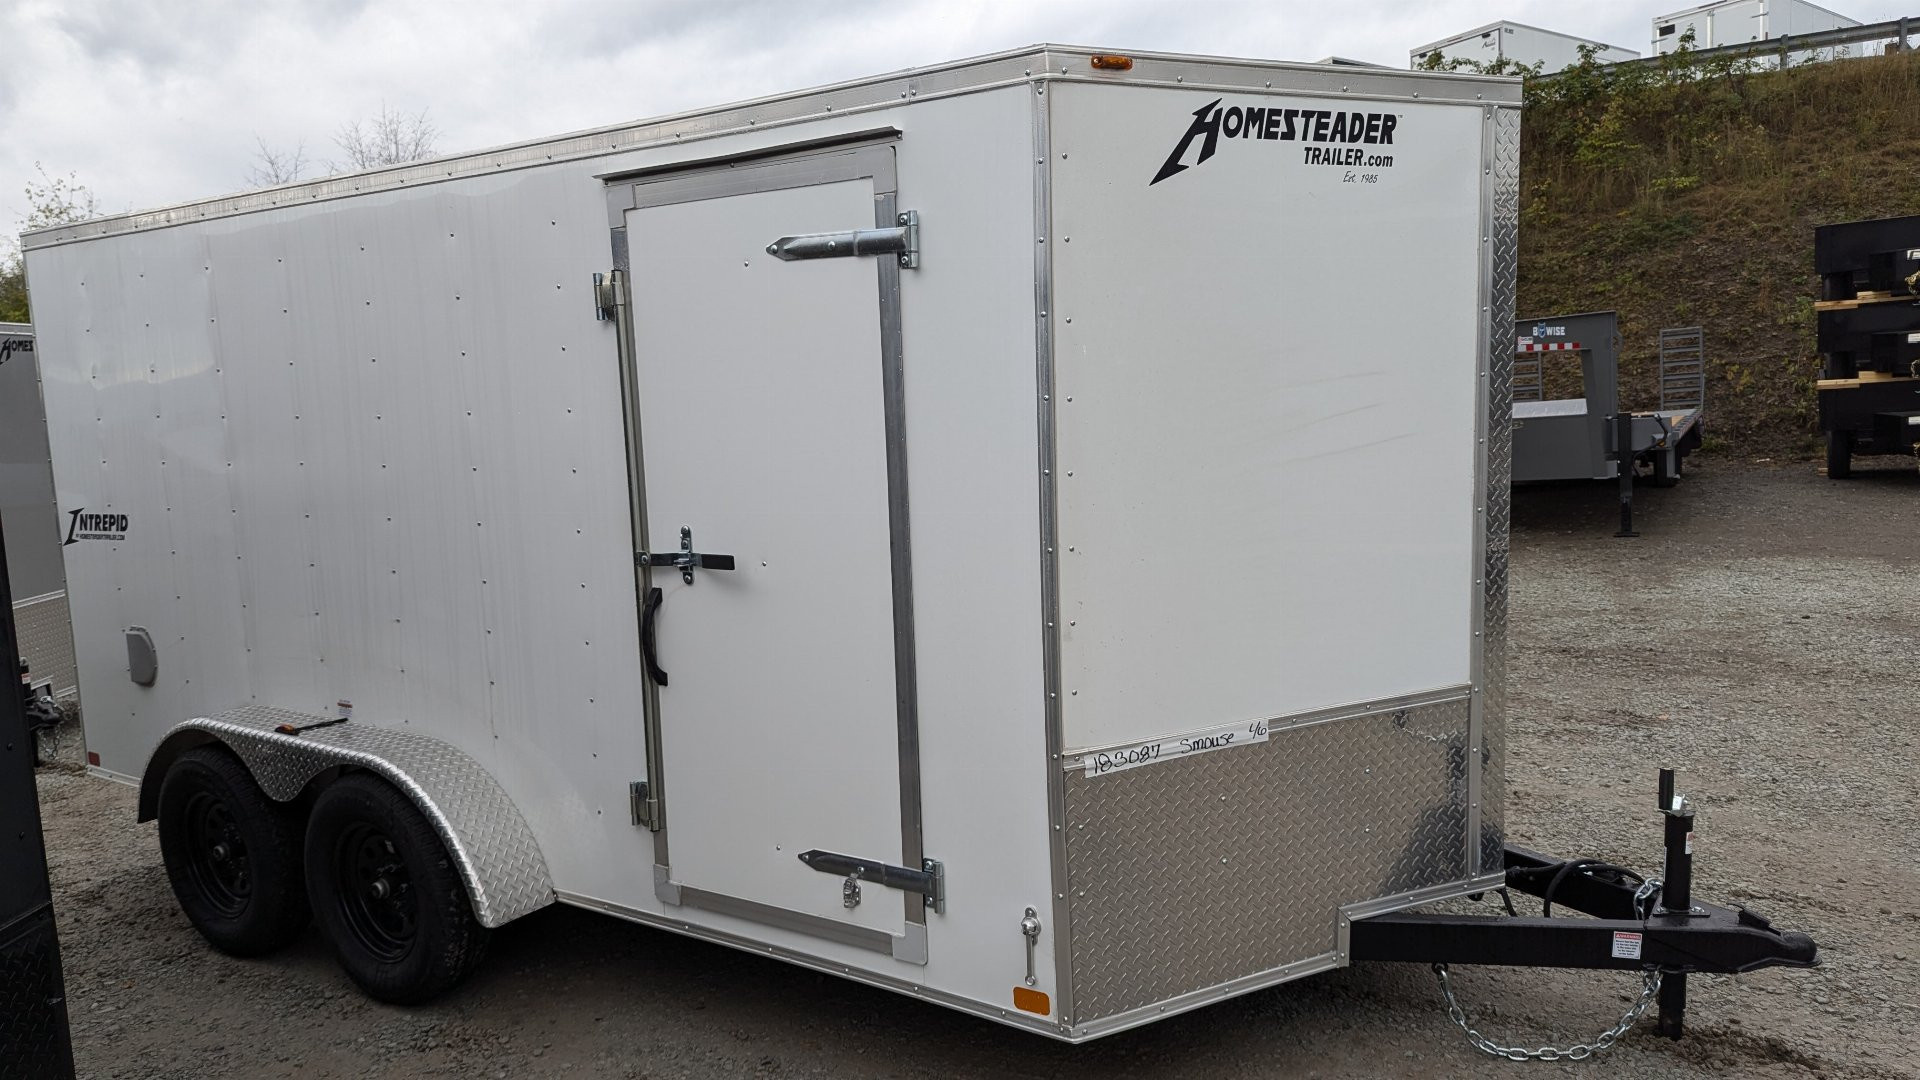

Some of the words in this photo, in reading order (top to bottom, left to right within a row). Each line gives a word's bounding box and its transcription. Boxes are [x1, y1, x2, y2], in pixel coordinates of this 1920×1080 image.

[1149, 97, 1397, 186] HOMESTEADER
[1304, 146, 1393, 167] TRAILER.com
[1361, 173, 1378, 183] 1985
[63, 507, 128, 546] INTREPID
[1093, 743, 1161, 774] 183087
[1179, 732, 1235, 754] Smouse
